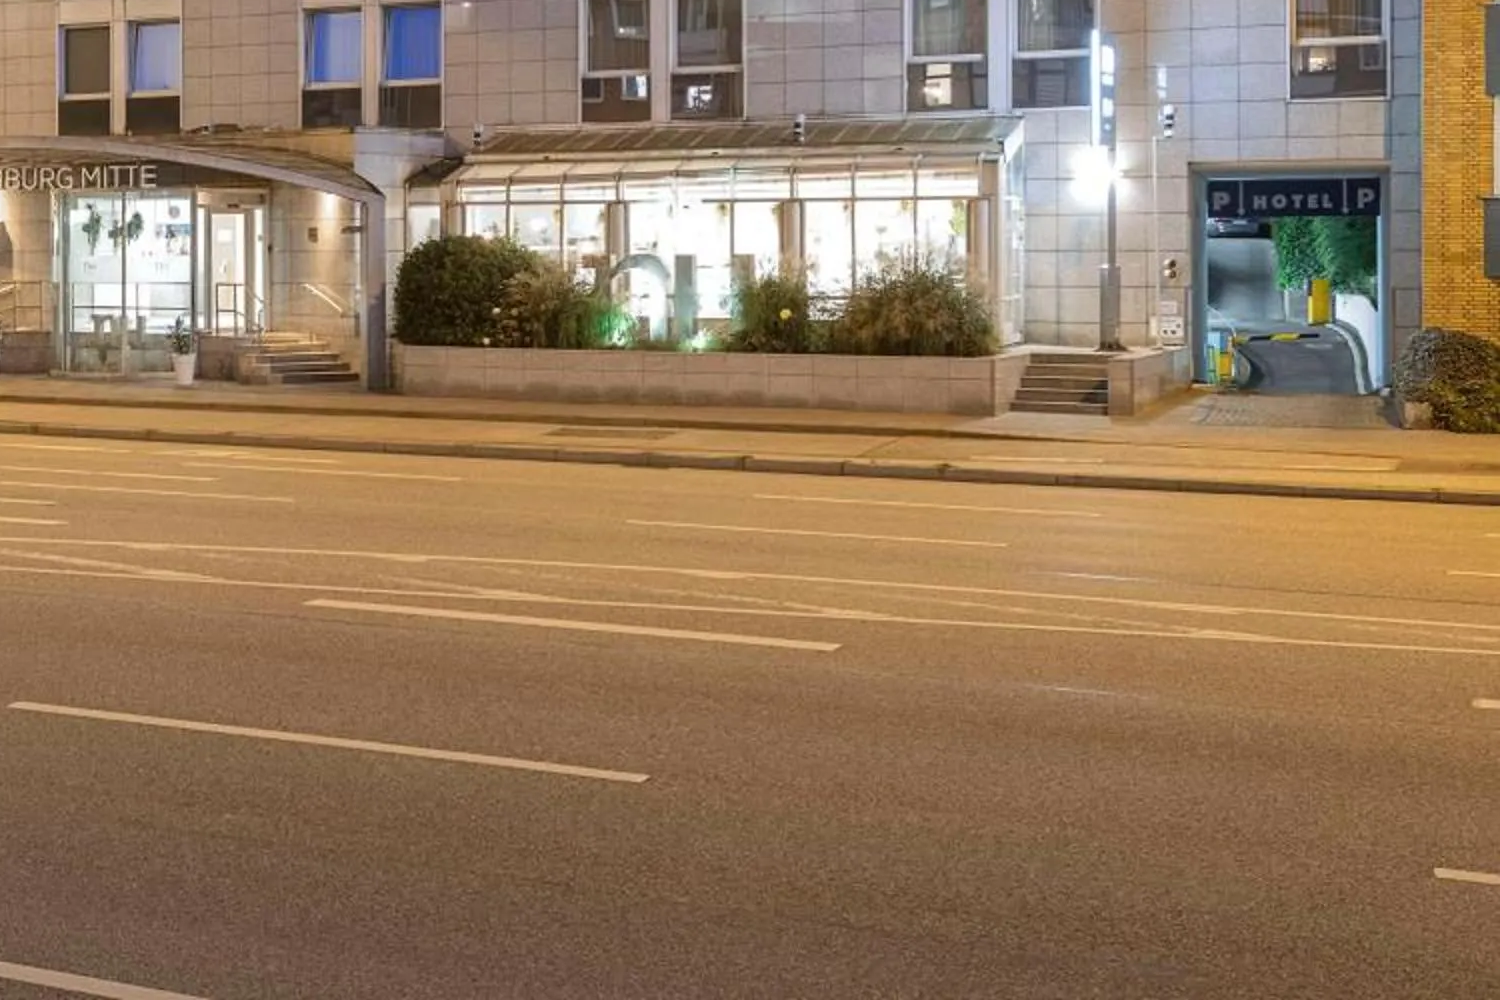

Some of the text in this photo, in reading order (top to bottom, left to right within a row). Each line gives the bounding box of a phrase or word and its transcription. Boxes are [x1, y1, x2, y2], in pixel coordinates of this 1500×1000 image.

[80, 164, 158, 189] MITTE
[1211, 187, 1375, 211] P HOTEL P
